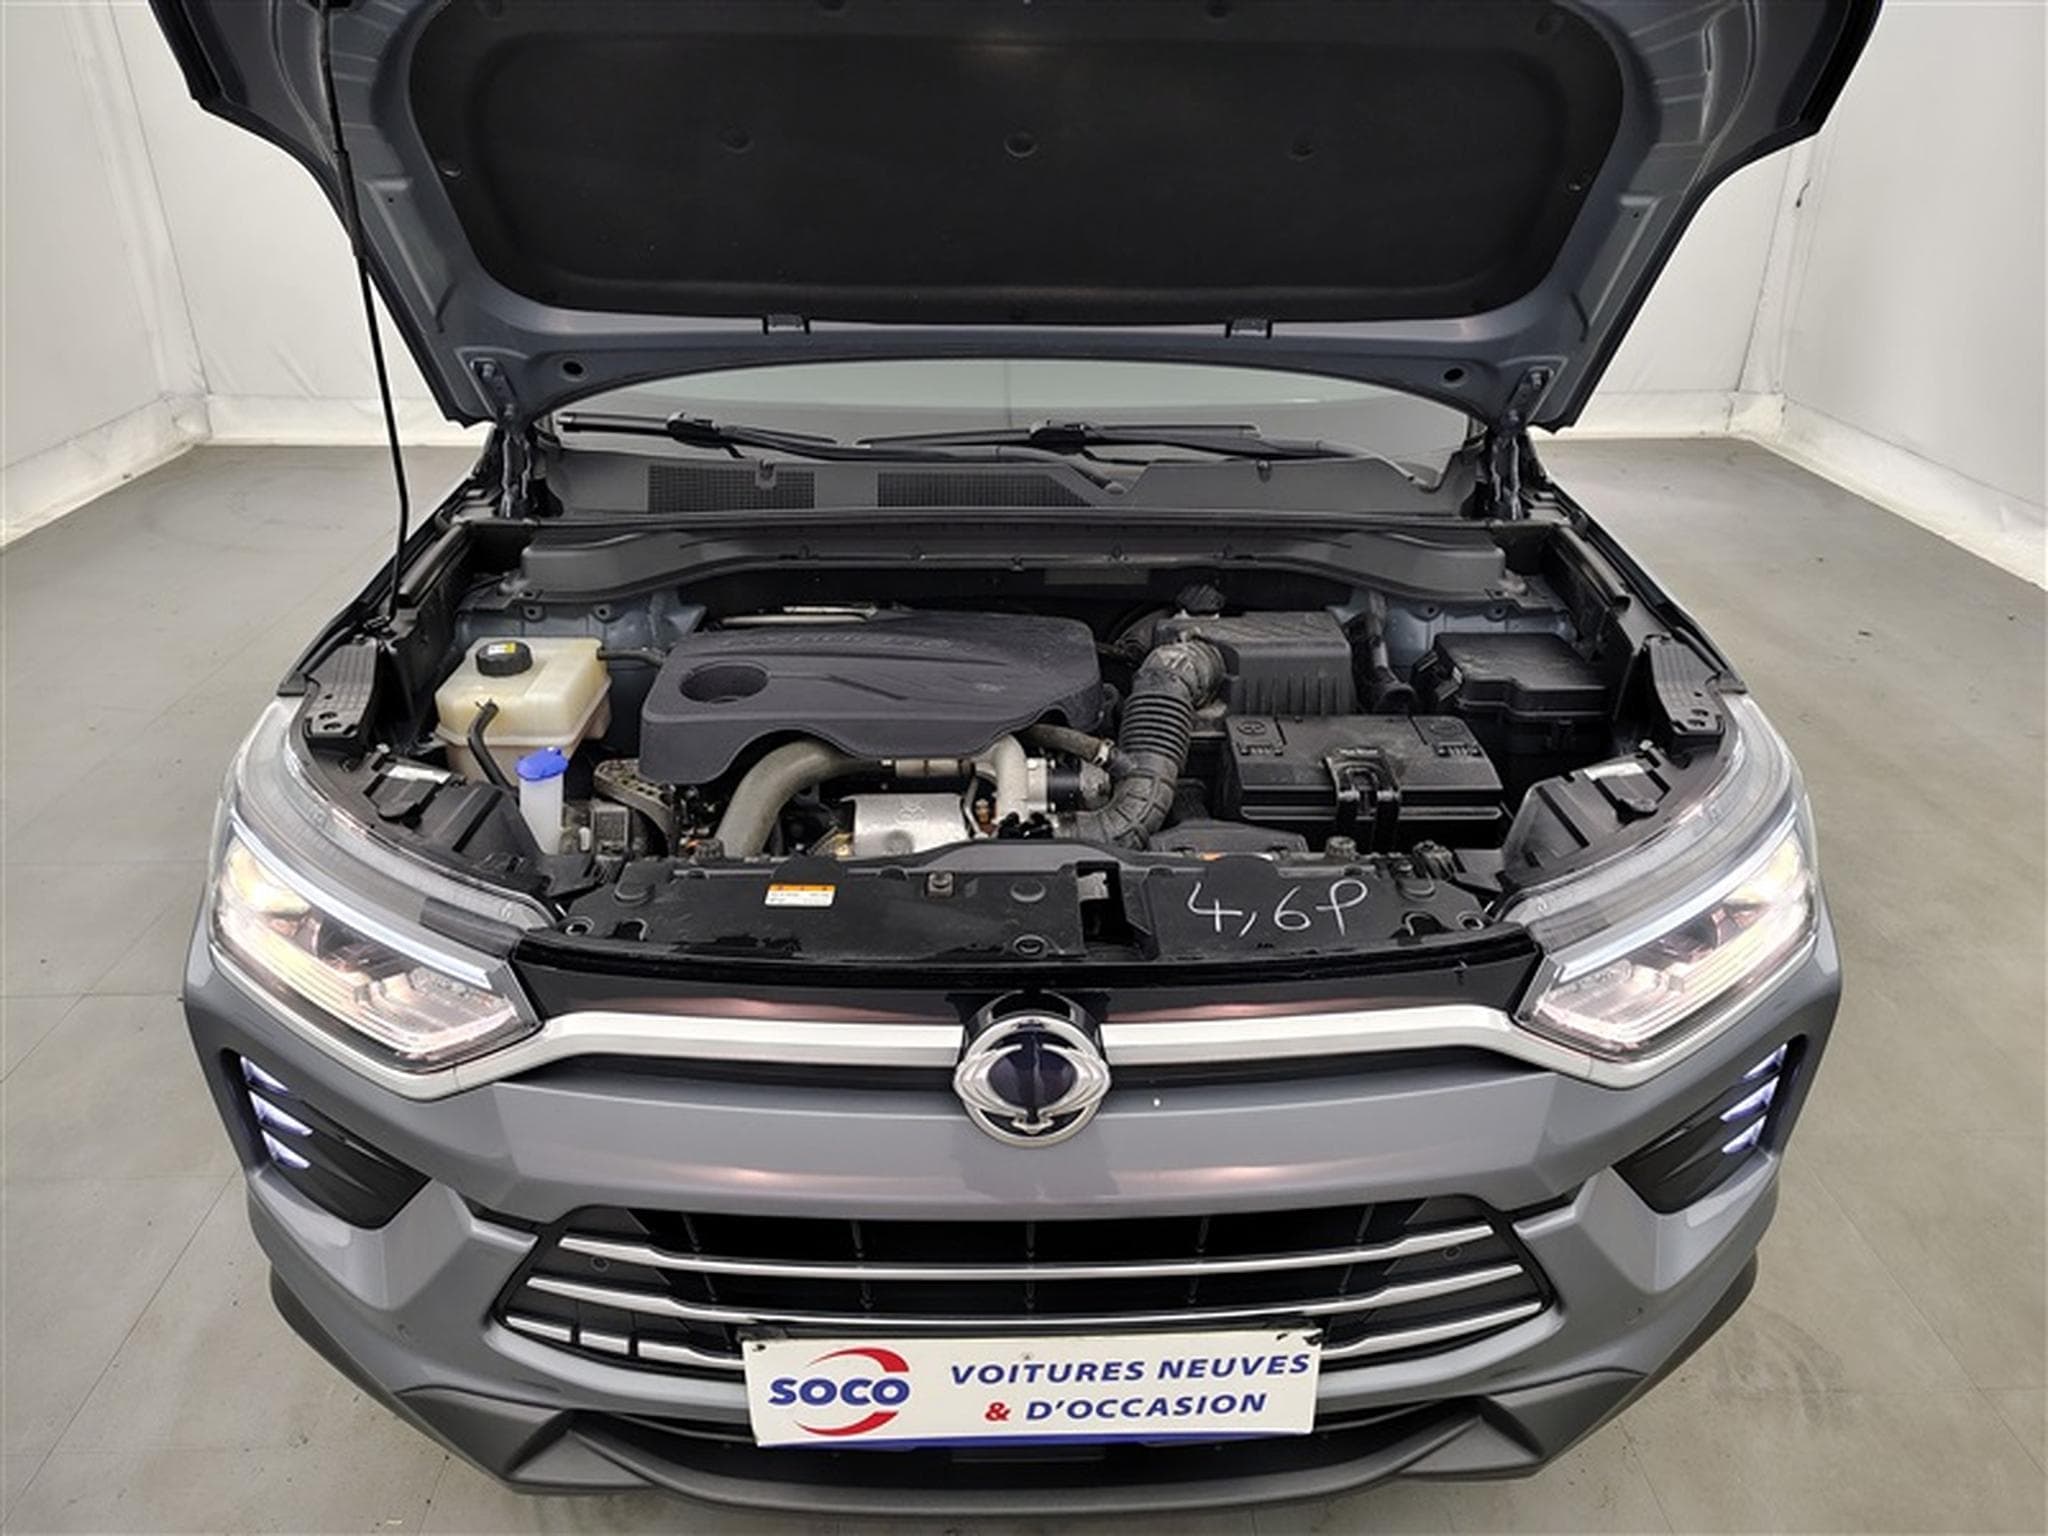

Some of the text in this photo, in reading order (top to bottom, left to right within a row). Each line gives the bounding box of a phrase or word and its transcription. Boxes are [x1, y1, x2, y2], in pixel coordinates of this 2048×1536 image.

[951, 1353, 1311, 1385] VOITURES NEUVES
[768, 1376, 910, 1406] SOCO
[985, 1393, 1268, 1422] & D'OCCASION
